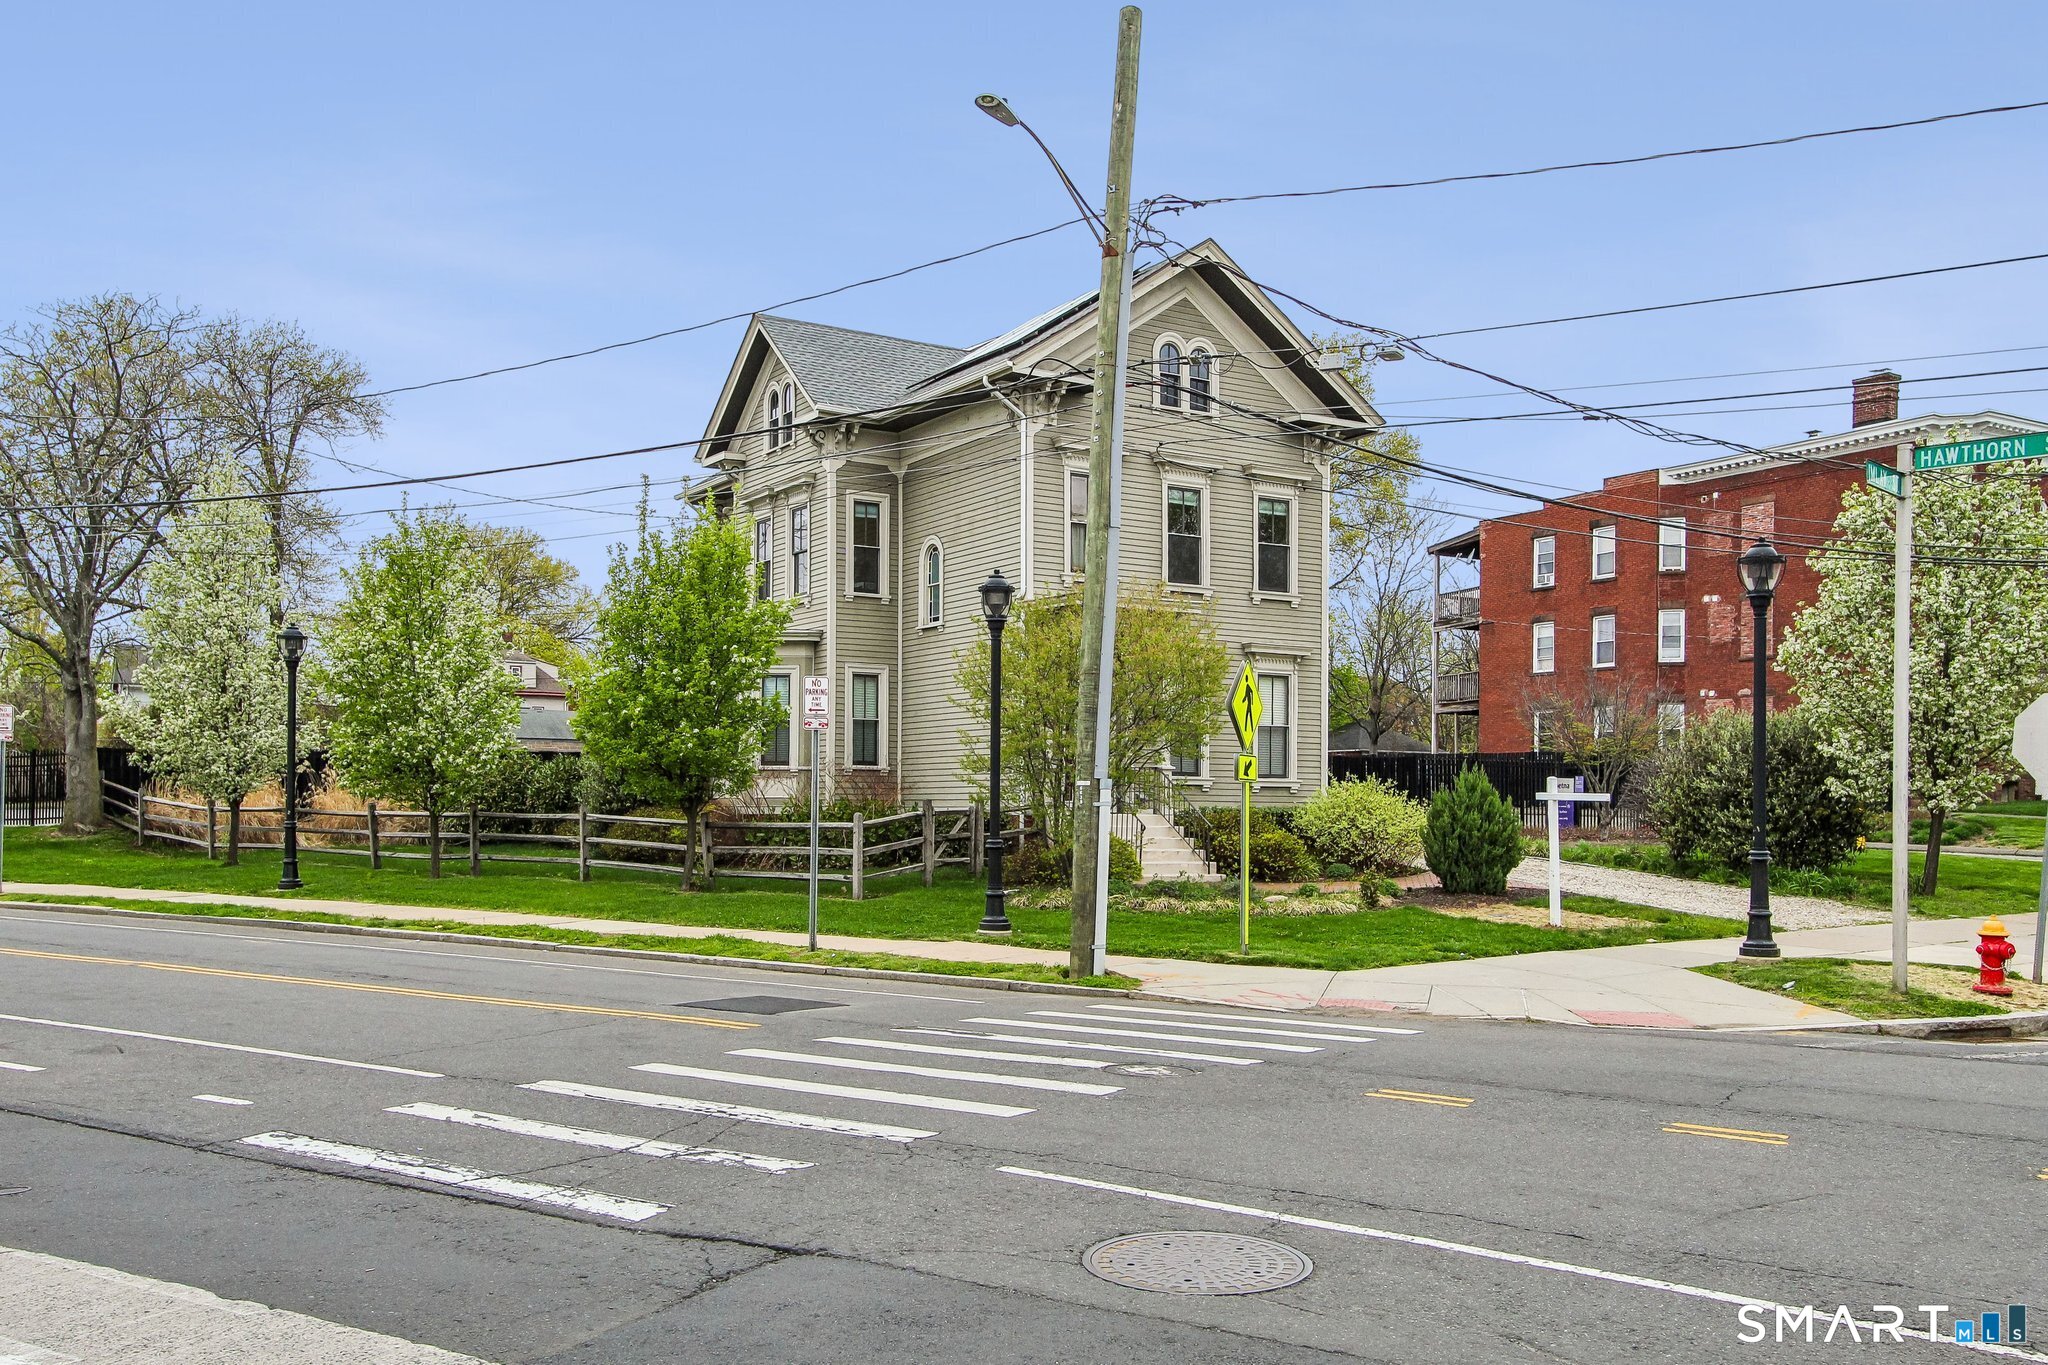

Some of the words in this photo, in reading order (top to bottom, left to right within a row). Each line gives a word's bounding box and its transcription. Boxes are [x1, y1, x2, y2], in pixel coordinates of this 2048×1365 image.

[1920, 438, 2026, 468] HAWTHORN
[811, 679, 822, 688] NO
[805, 688, 828, 696] PARKING
